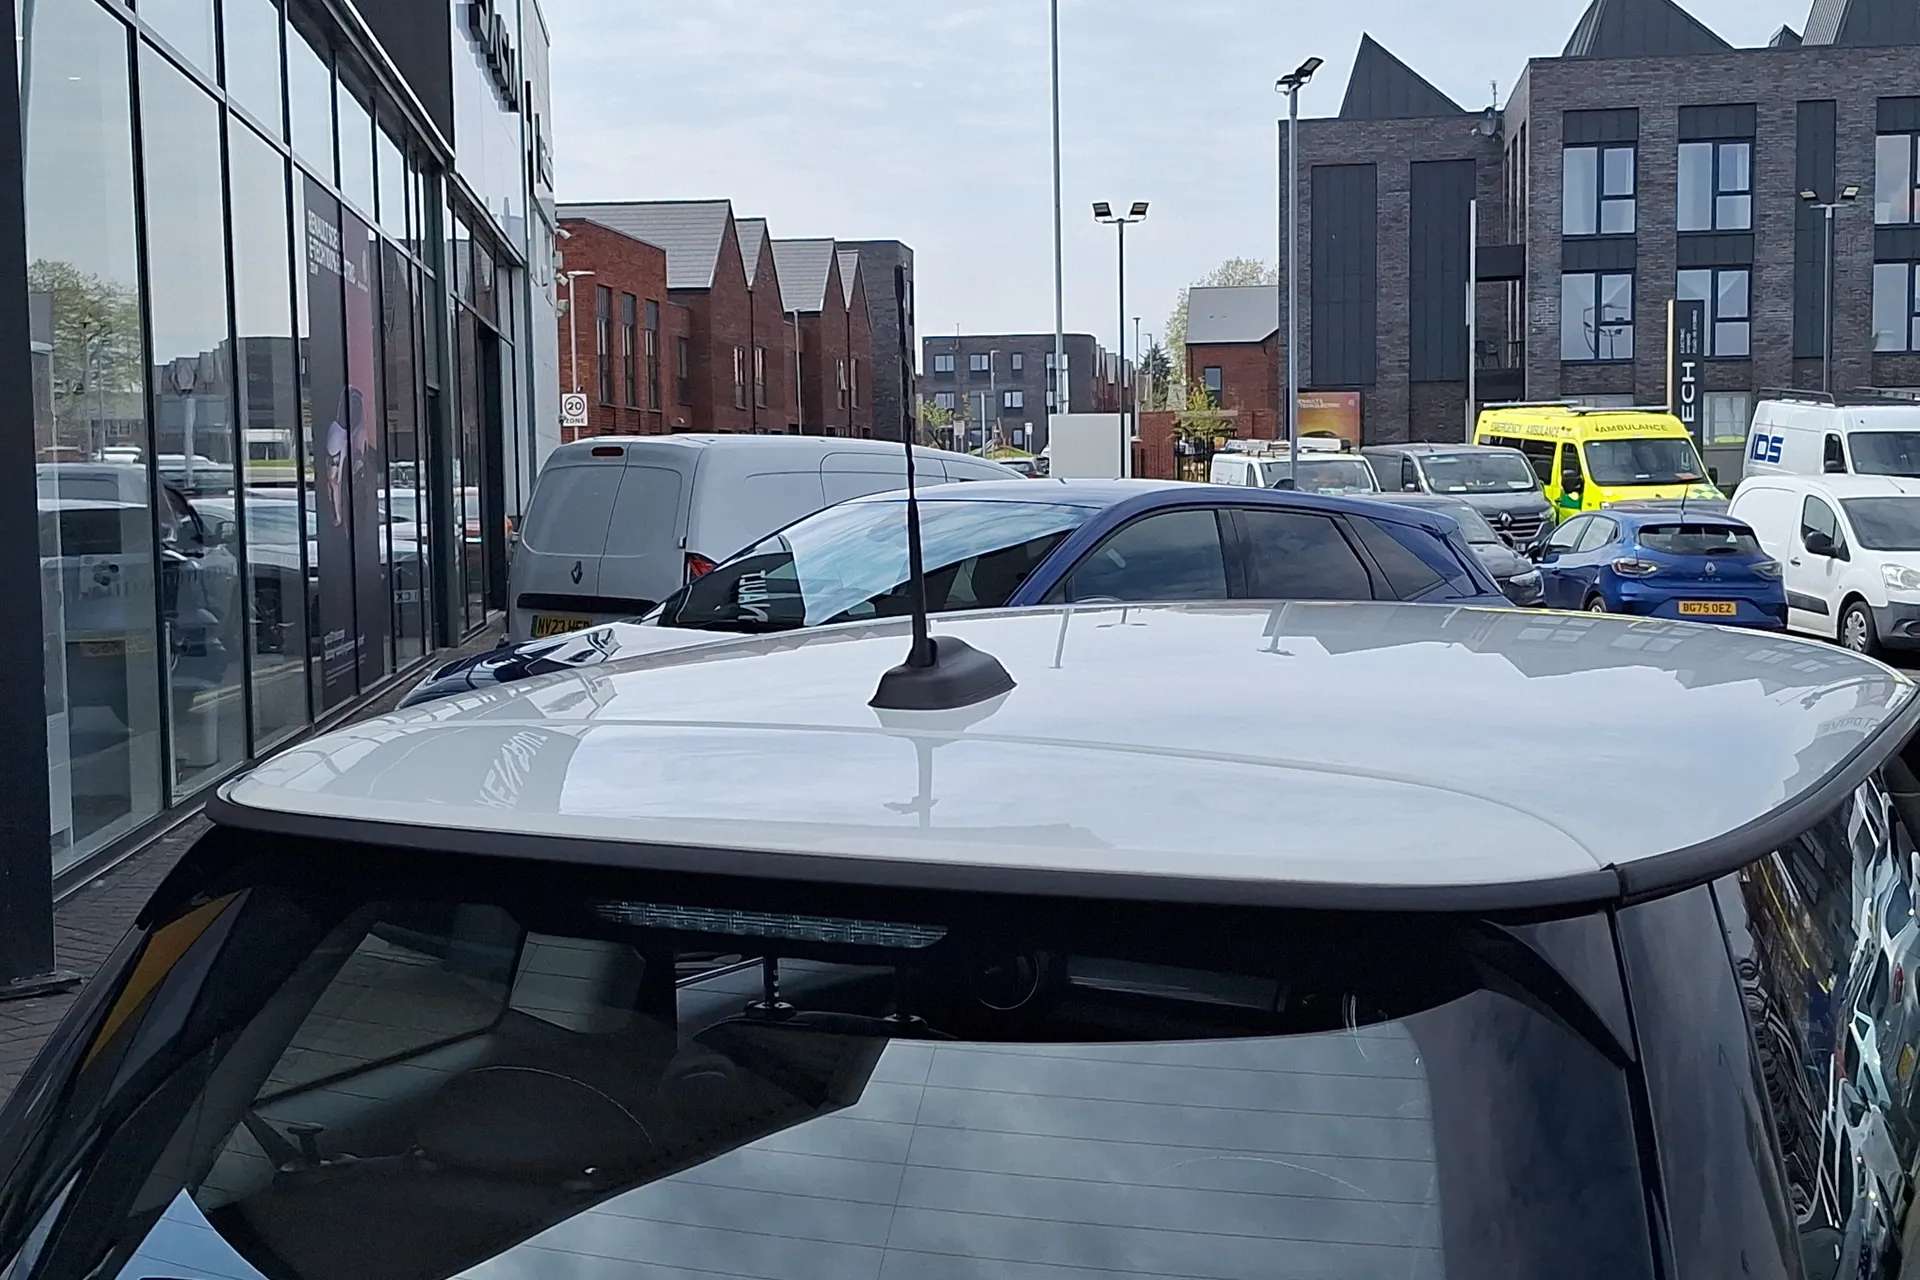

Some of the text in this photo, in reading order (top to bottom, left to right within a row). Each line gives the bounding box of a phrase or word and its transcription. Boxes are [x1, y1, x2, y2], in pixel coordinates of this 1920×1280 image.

[1681, 362, 1696, 435] ECH
[567, 401, 582, 411] 20
[1600, 424, 1669, 433] AMBULANCE
[1683, 603, 1710, 612] BG75
